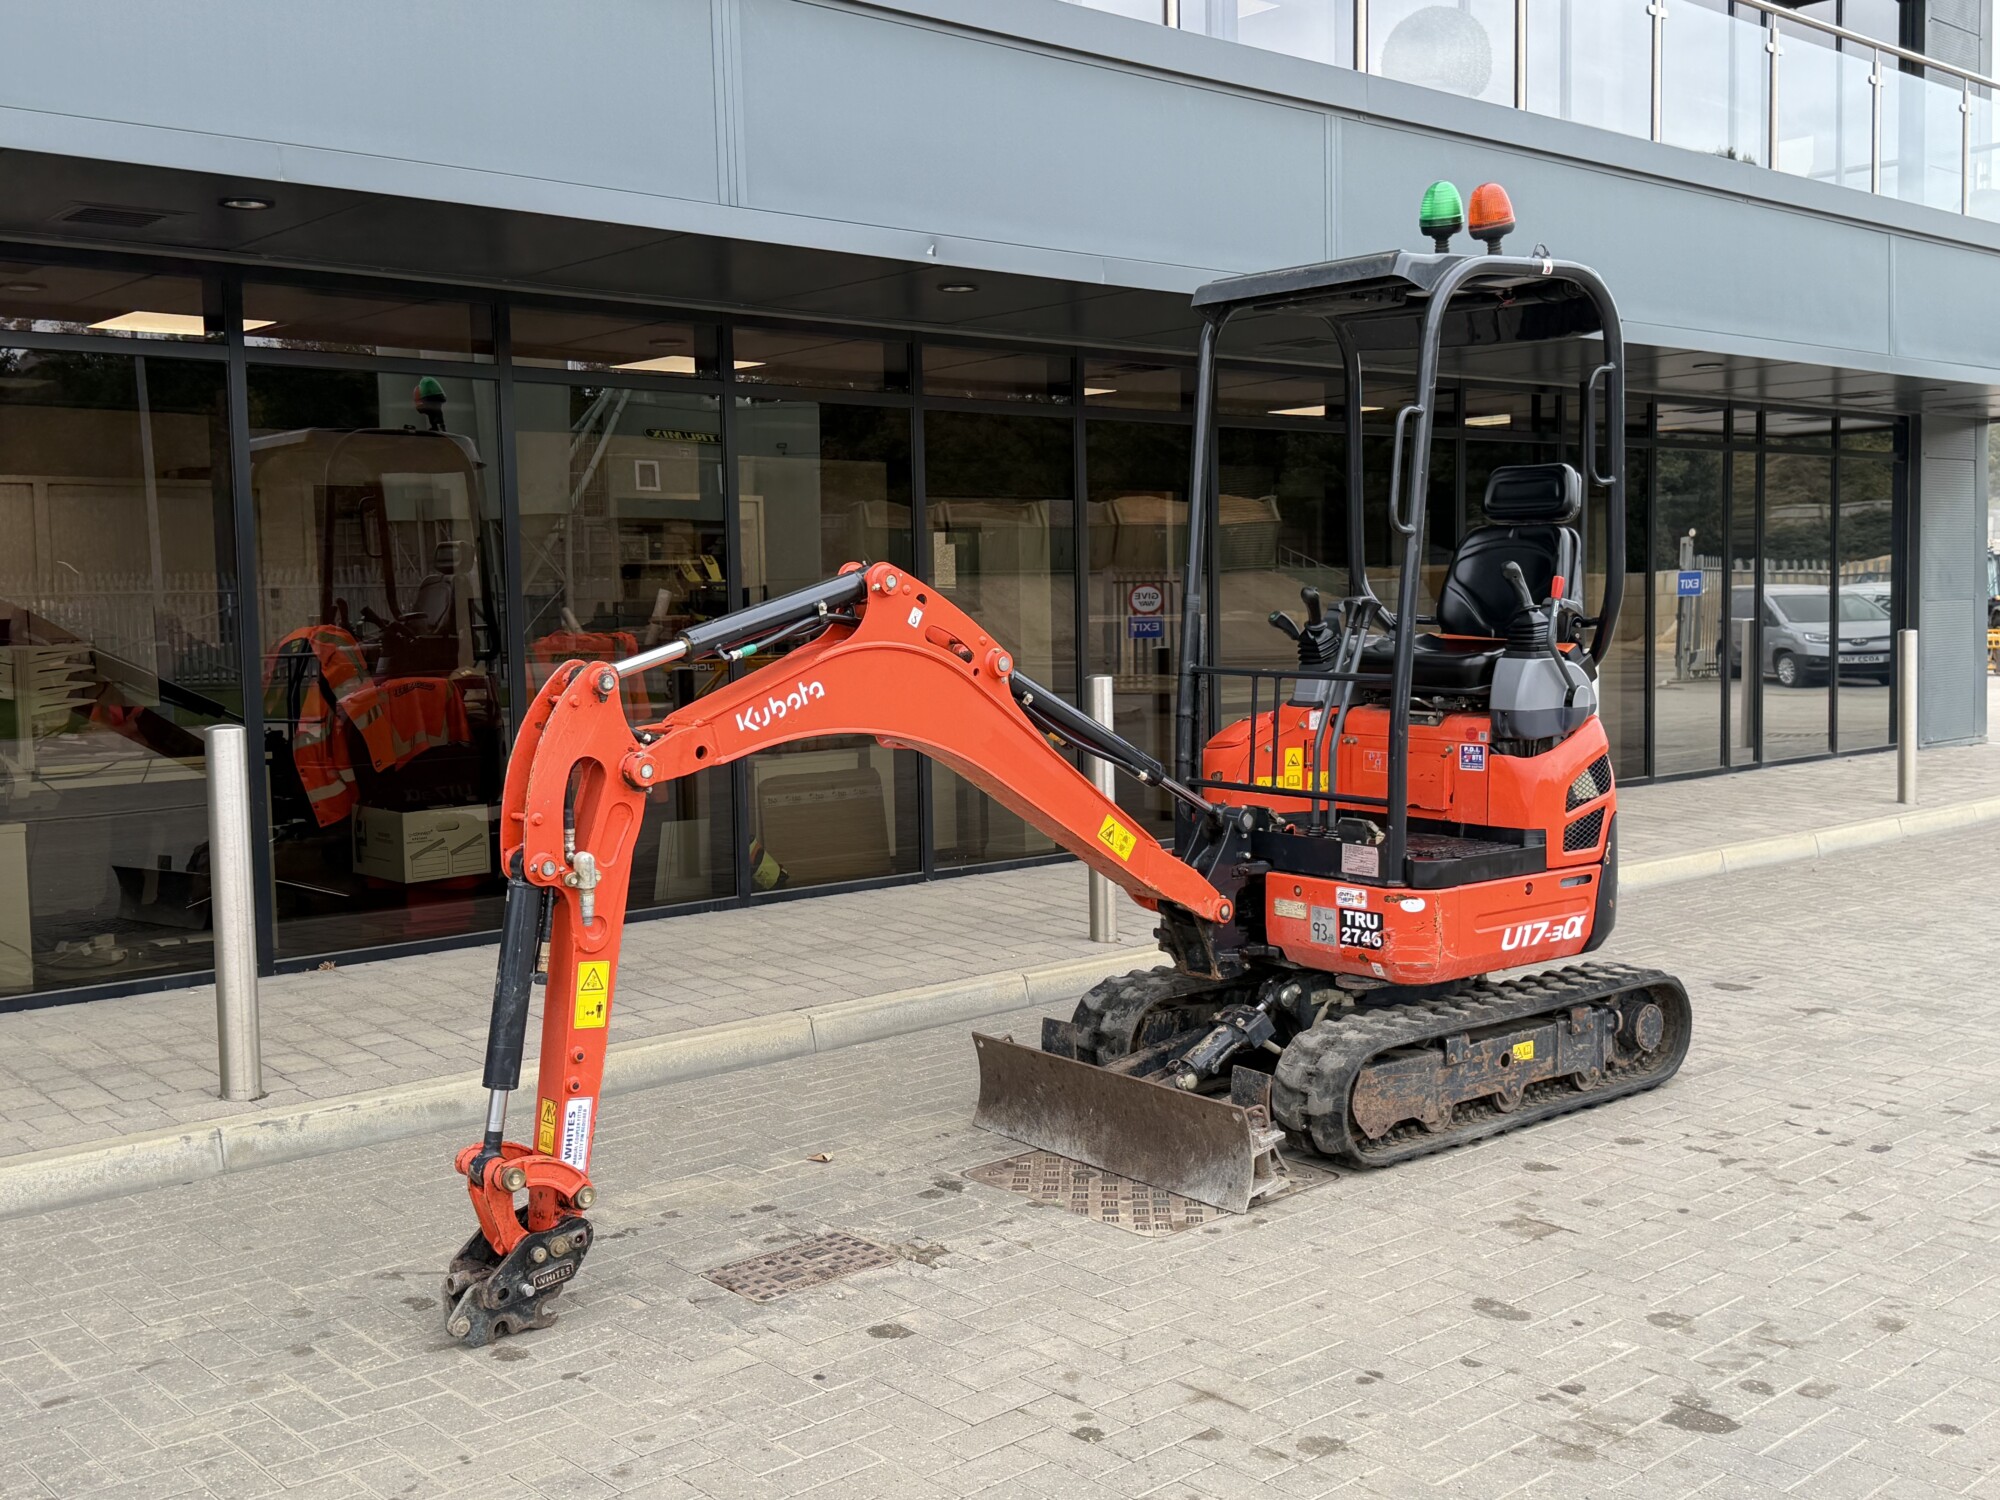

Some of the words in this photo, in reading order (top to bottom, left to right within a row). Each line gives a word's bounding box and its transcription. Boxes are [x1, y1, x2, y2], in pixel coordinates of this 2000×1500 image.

[735, 681, 825, 732] Kubota
[1343, 910, 1379, 930] TRU
[1313, 922, 1328, 941] 93
[1341, 926, 1382, 948] 2746
[564, 1111, 576, 1160] WHITES
[537, 1266, 571, 1284] WHITES
